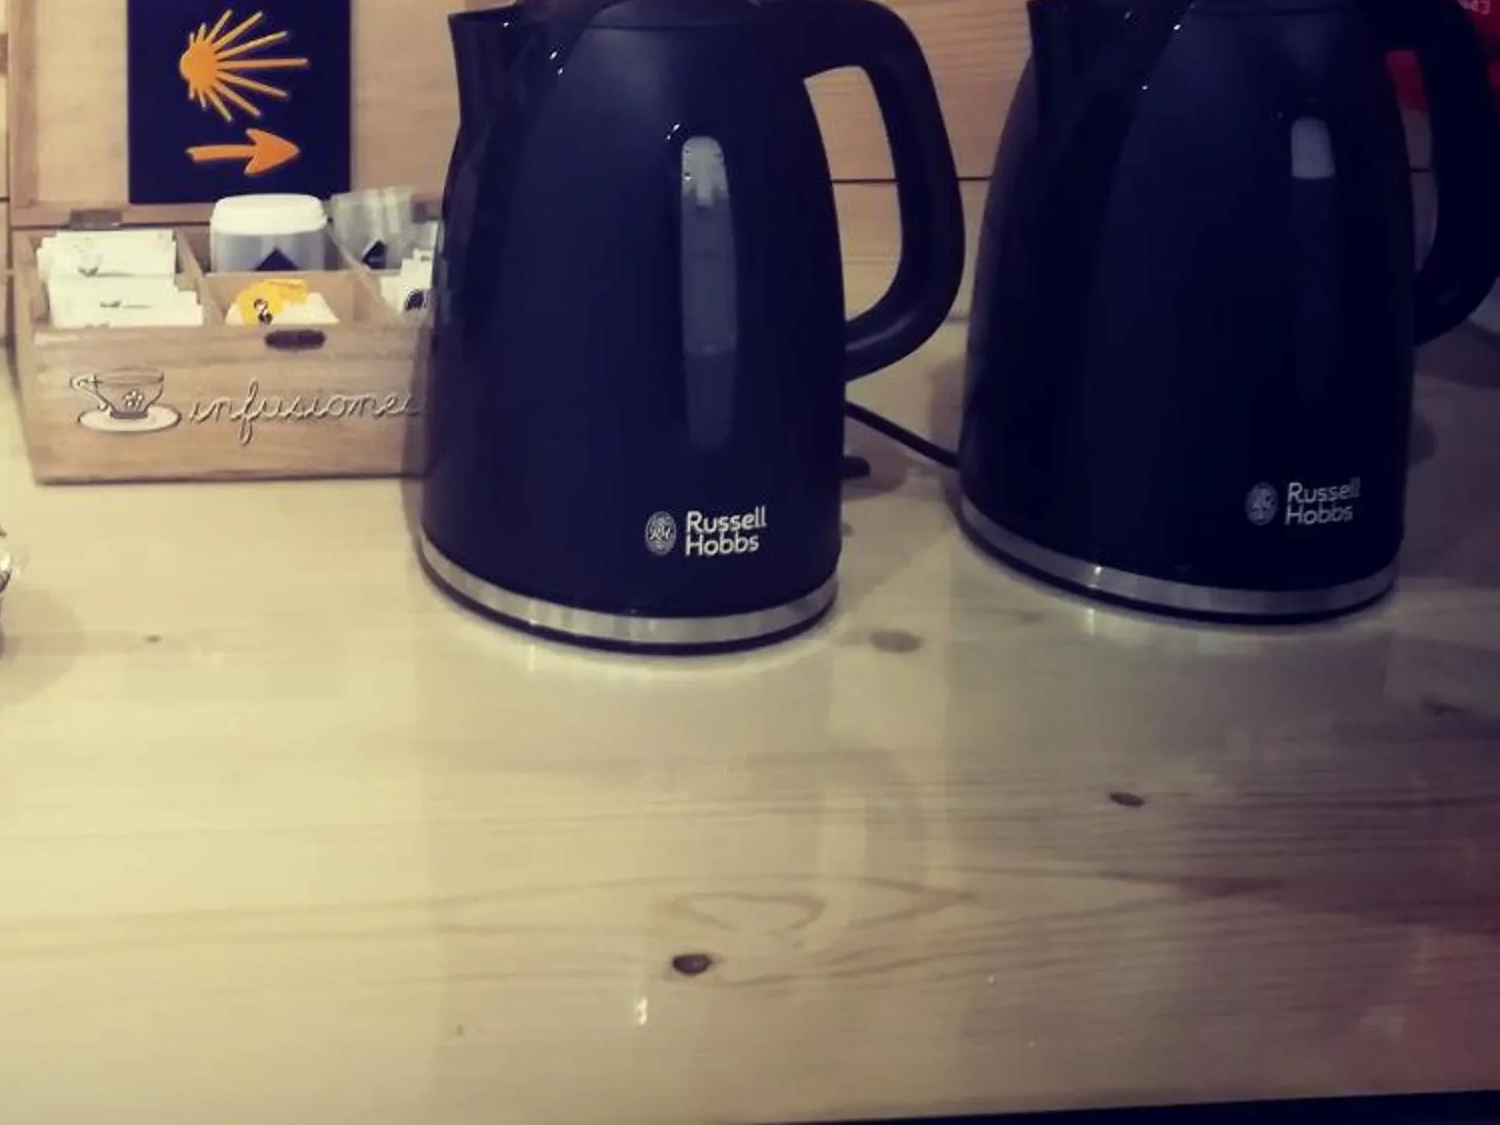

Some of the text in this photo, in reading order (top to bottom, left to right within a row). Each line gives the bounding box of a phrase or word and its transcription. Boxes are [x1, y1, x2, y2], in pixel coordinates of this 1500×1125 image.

[1285, 476, 1361, 503] Russell
[685, 505, 768, 534] Russell
[1284, 501, 1354, 526] Hobbs
[684, 531, 760, 557] Hobbs
